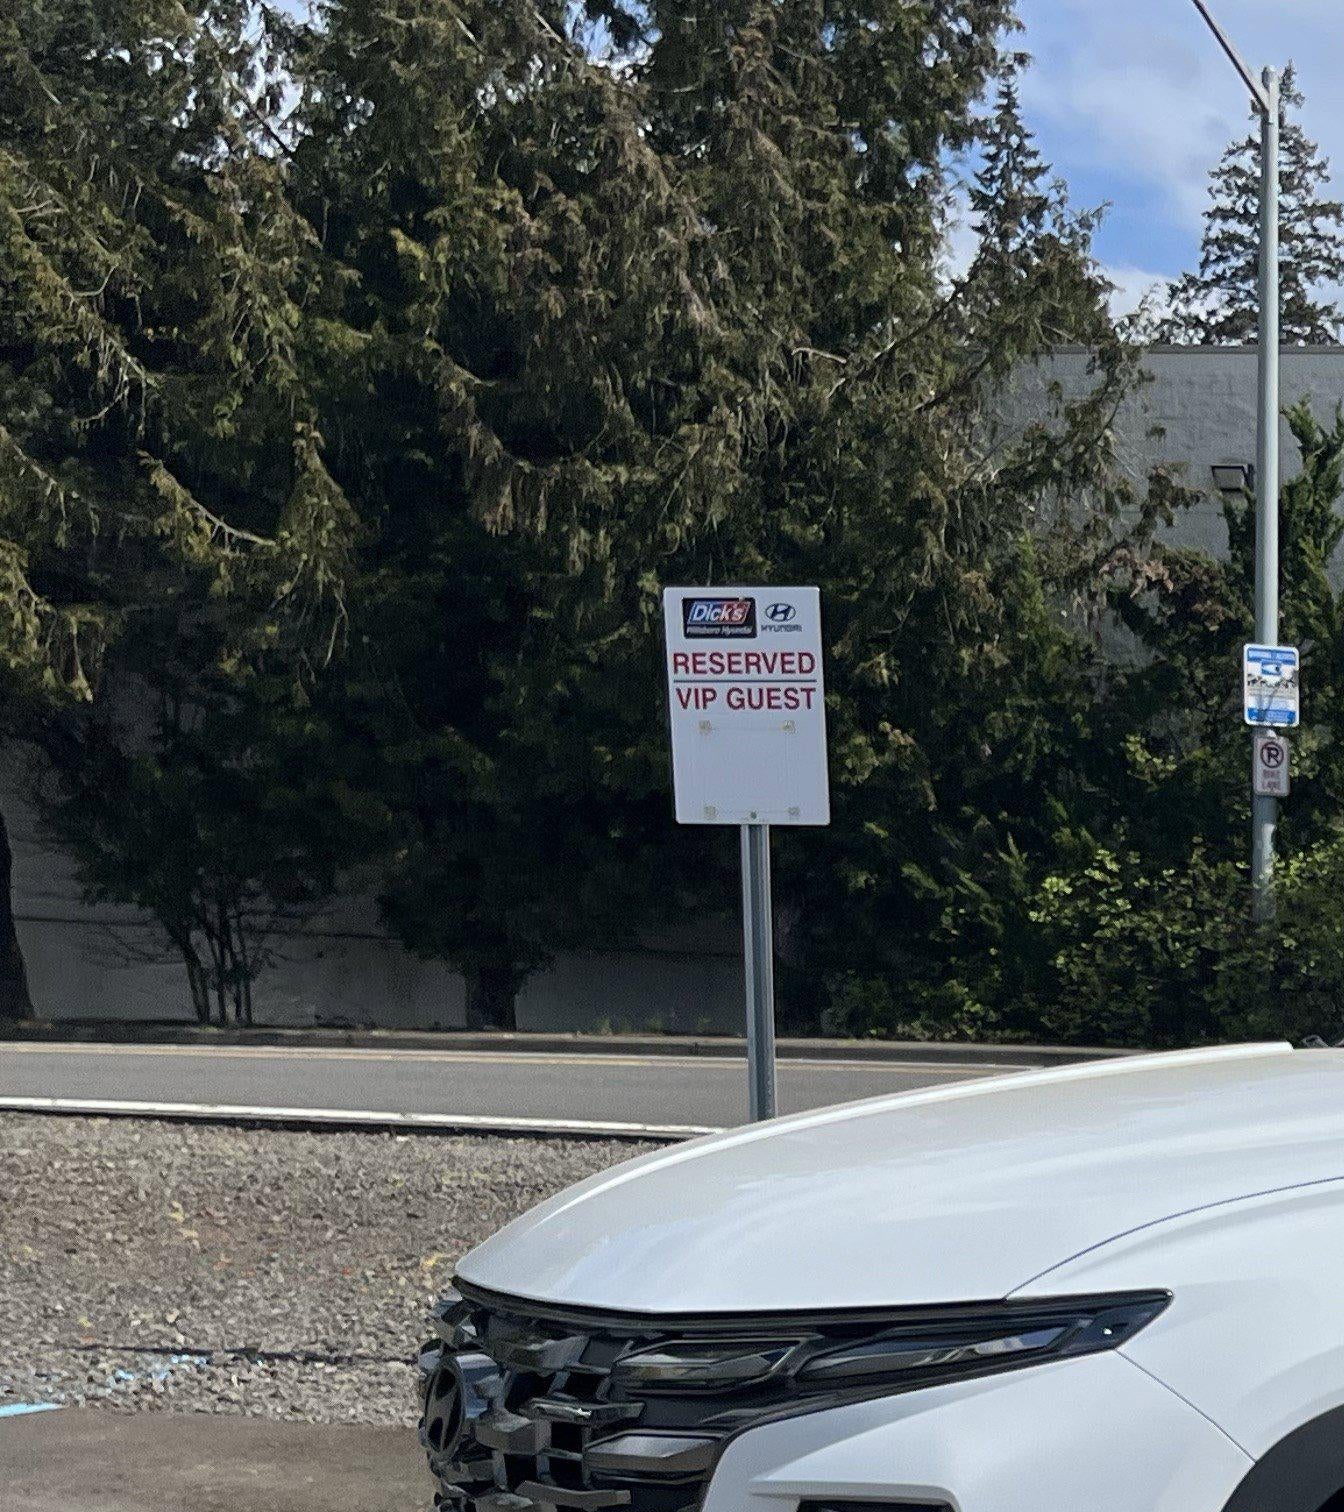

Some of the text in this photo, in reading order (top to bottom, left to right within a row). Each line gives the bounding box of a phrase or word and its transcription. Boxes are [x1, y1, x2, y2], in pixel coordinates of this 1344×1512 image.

[673, 652, 816, 674] RESERVED
[676, 687, 817, 711] VIP GUEST
